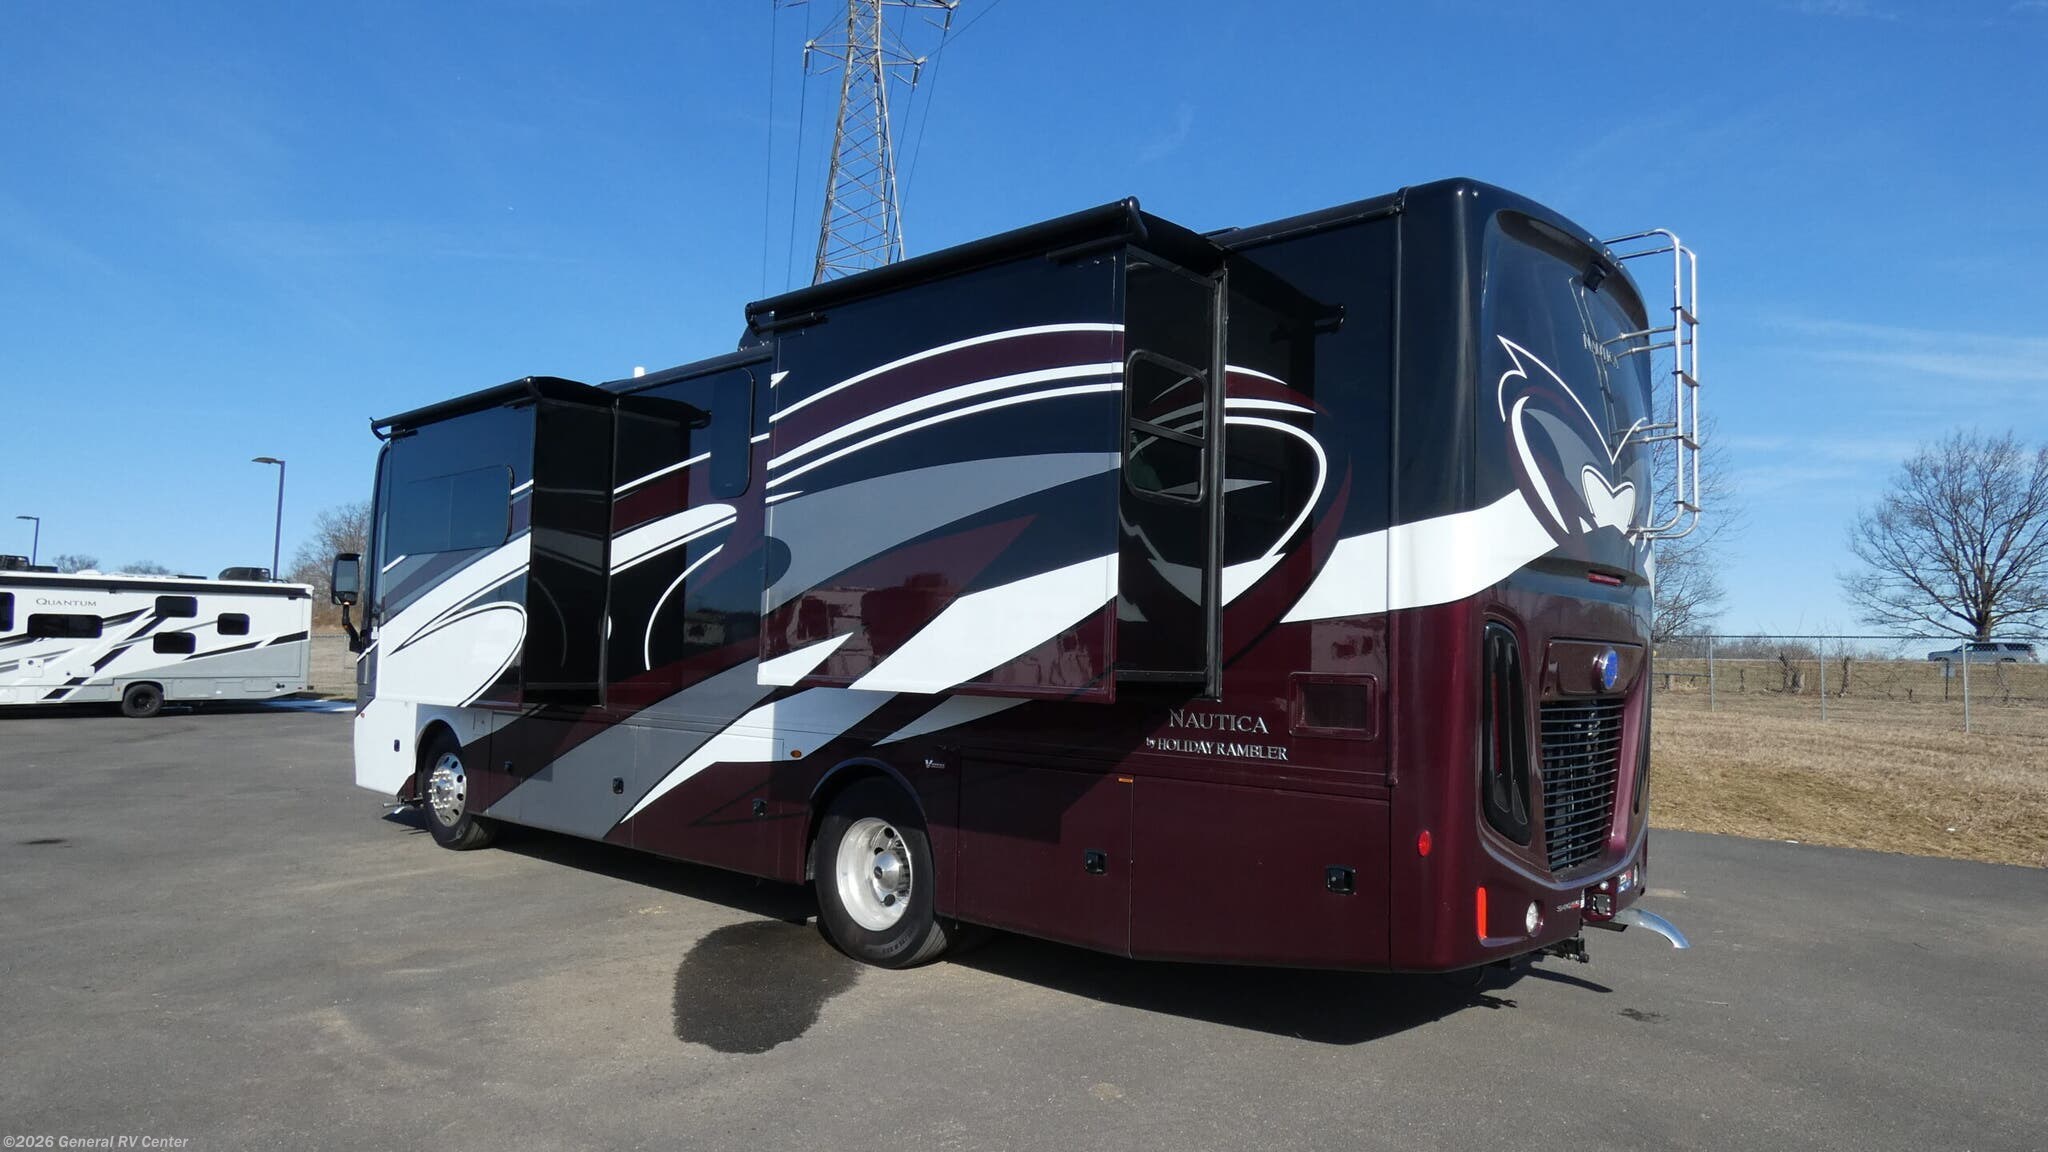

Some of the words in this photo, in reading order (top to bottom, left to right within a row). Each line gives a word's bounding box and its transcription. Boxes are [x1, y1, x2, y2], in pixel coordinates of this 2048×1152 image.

[36, 598, 97, 607] QUANTUM
[1168, 708, 1269, 734] NAUTICA
[1158, 738, 1215, 755] HOLIDAY
[1217, 742, 1288, 760] RAMBLER
